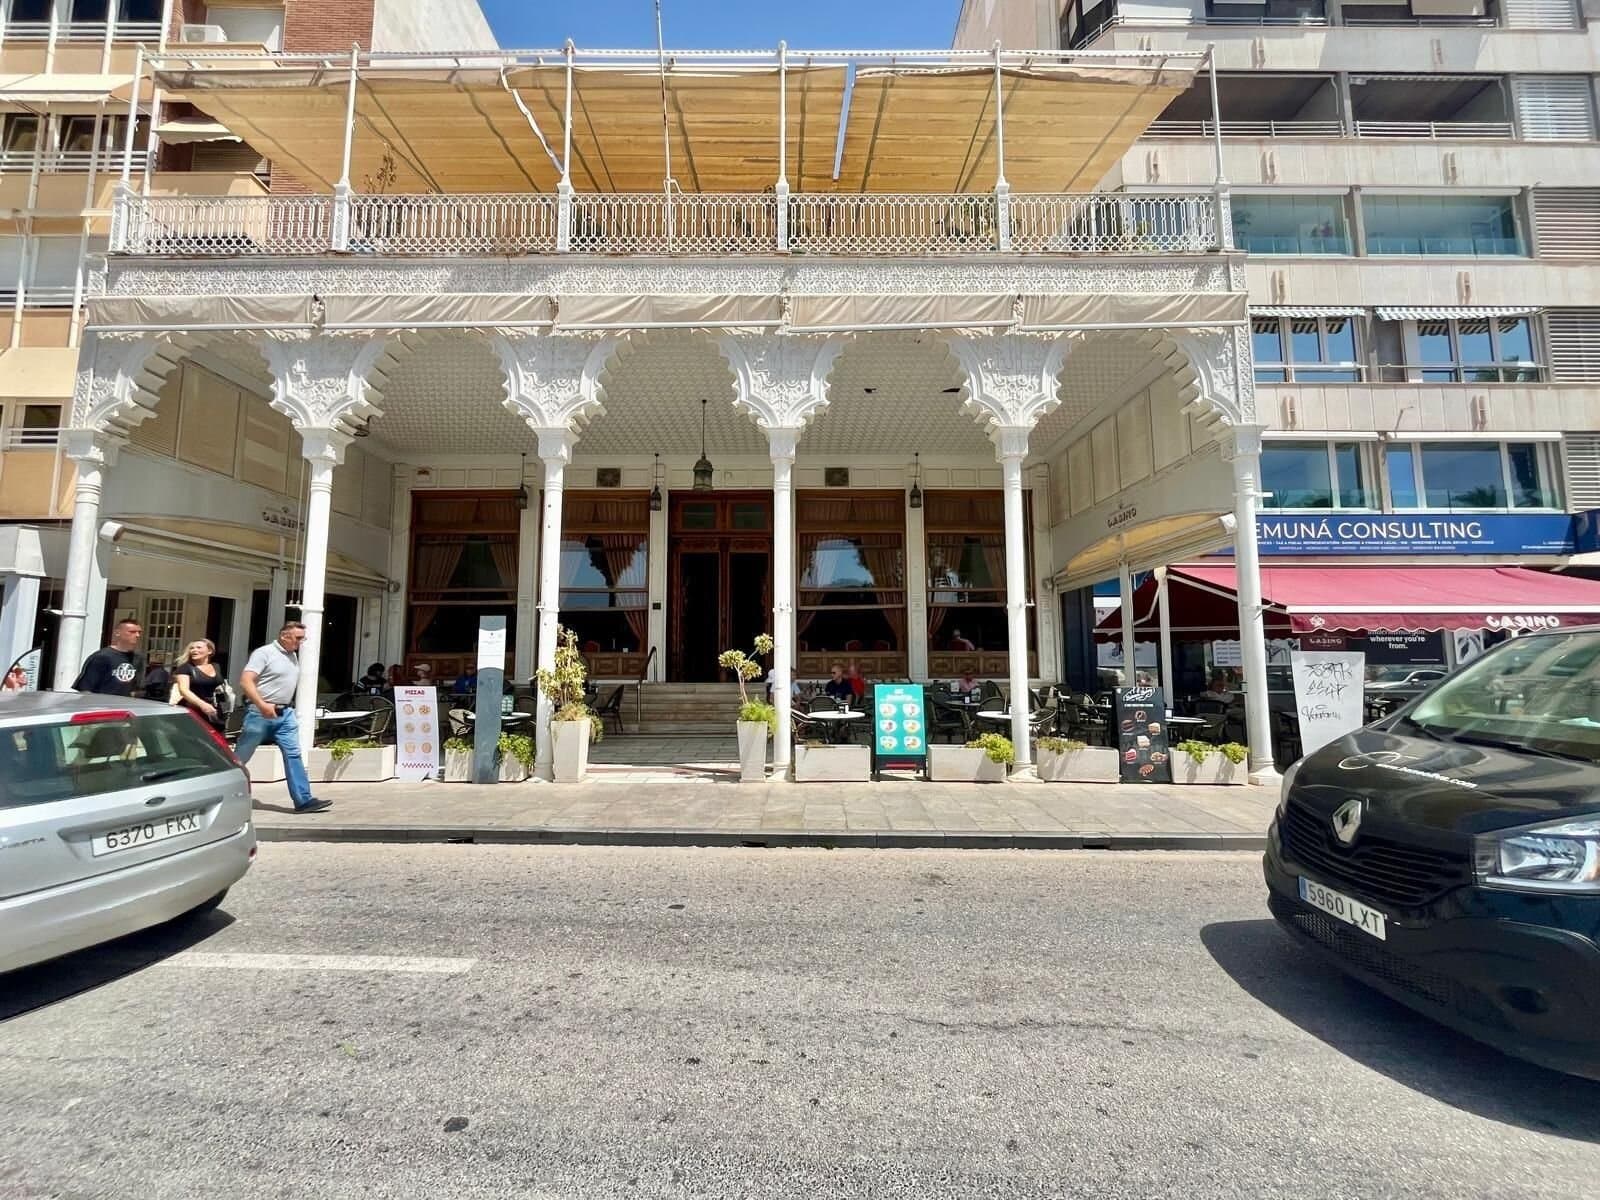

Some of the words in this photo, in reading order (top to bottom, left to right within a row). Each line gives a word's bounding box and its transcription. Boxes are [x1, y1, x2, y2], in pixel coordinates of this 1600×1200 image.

[1337, 521, 1482, 539] CONSULTING
[1486, 615, 1560, 628] CASINO
[106, 823, 154, 849] 6370
[166, 813, 197, 835] FKX
[1308, 883, 1344, 916] 5960
[1349, 902, 1380, 933] LXT
